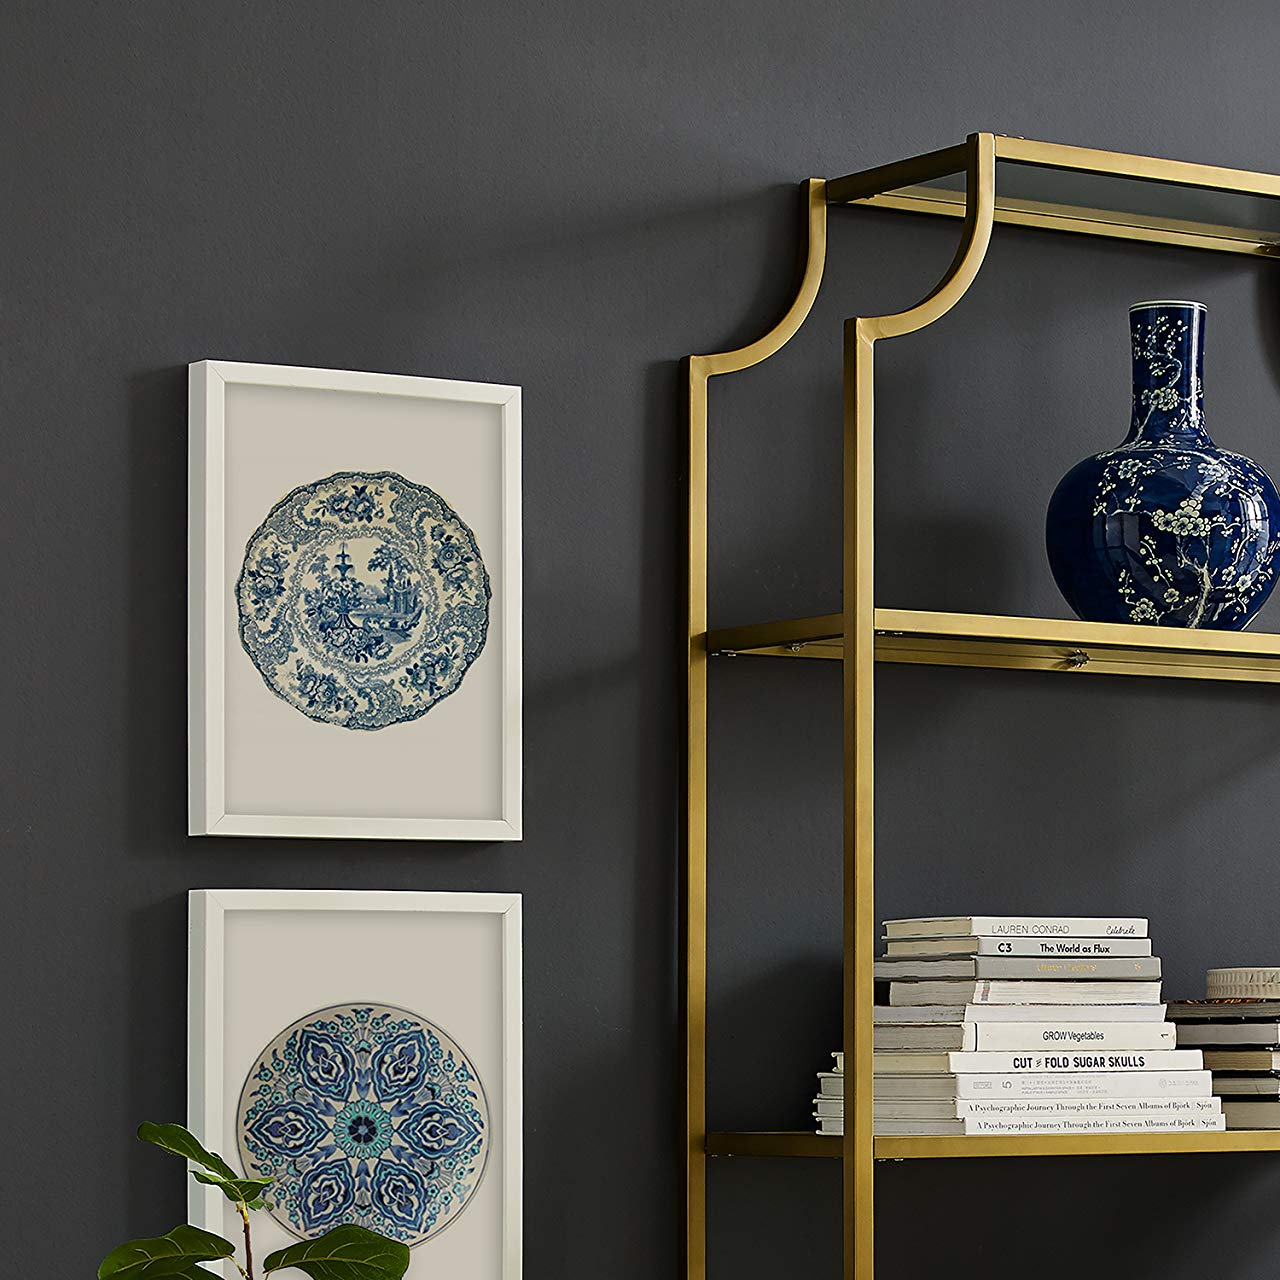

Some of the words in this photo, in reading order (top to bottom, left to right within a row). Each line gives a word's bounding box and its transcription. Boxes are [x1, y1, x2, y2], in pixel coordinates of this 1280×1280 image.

[991, 924, 1029, 935] LAUREN
[1032, 924, 1070, 935] CONRAD
[997, 942, 1013, 954] C3
[1040, 943, 1055, 953] The
[1056, 943, 1080, 953] World
[1093, 943, 1111, 953] Flux
[1042, 1031, 1067, 1041] GROW
[1068, 1031, 1105, 1042] Vegetables
[1013, 1057, 1033, 1069] CUT
[1044, 1057, 1069, 1069] FOLD
[1073, 1056, 1106, 1068] SUGAR
[1108, 1056, 1145, 1068] SKULLS
[968, 1104, 974, 1112] A
[974, 1104, 1025, 1114] Psychographic
[1026, 1104, 1054, 1113] Journey
[1056, 1103, 1085, 1112] Through
[1086, 1103, 1097, 1111] the
[983, 1121, 1033, 1131] Psychographic
[1034, 1121, 1061, 1130] Journey
[1063, 1120, 1092, 1129] Through
[1093, 1120, 1104, 1128] the
[1105, 1120, 1121, 1128] First
[1169, 1119, 1177, 1127] of
